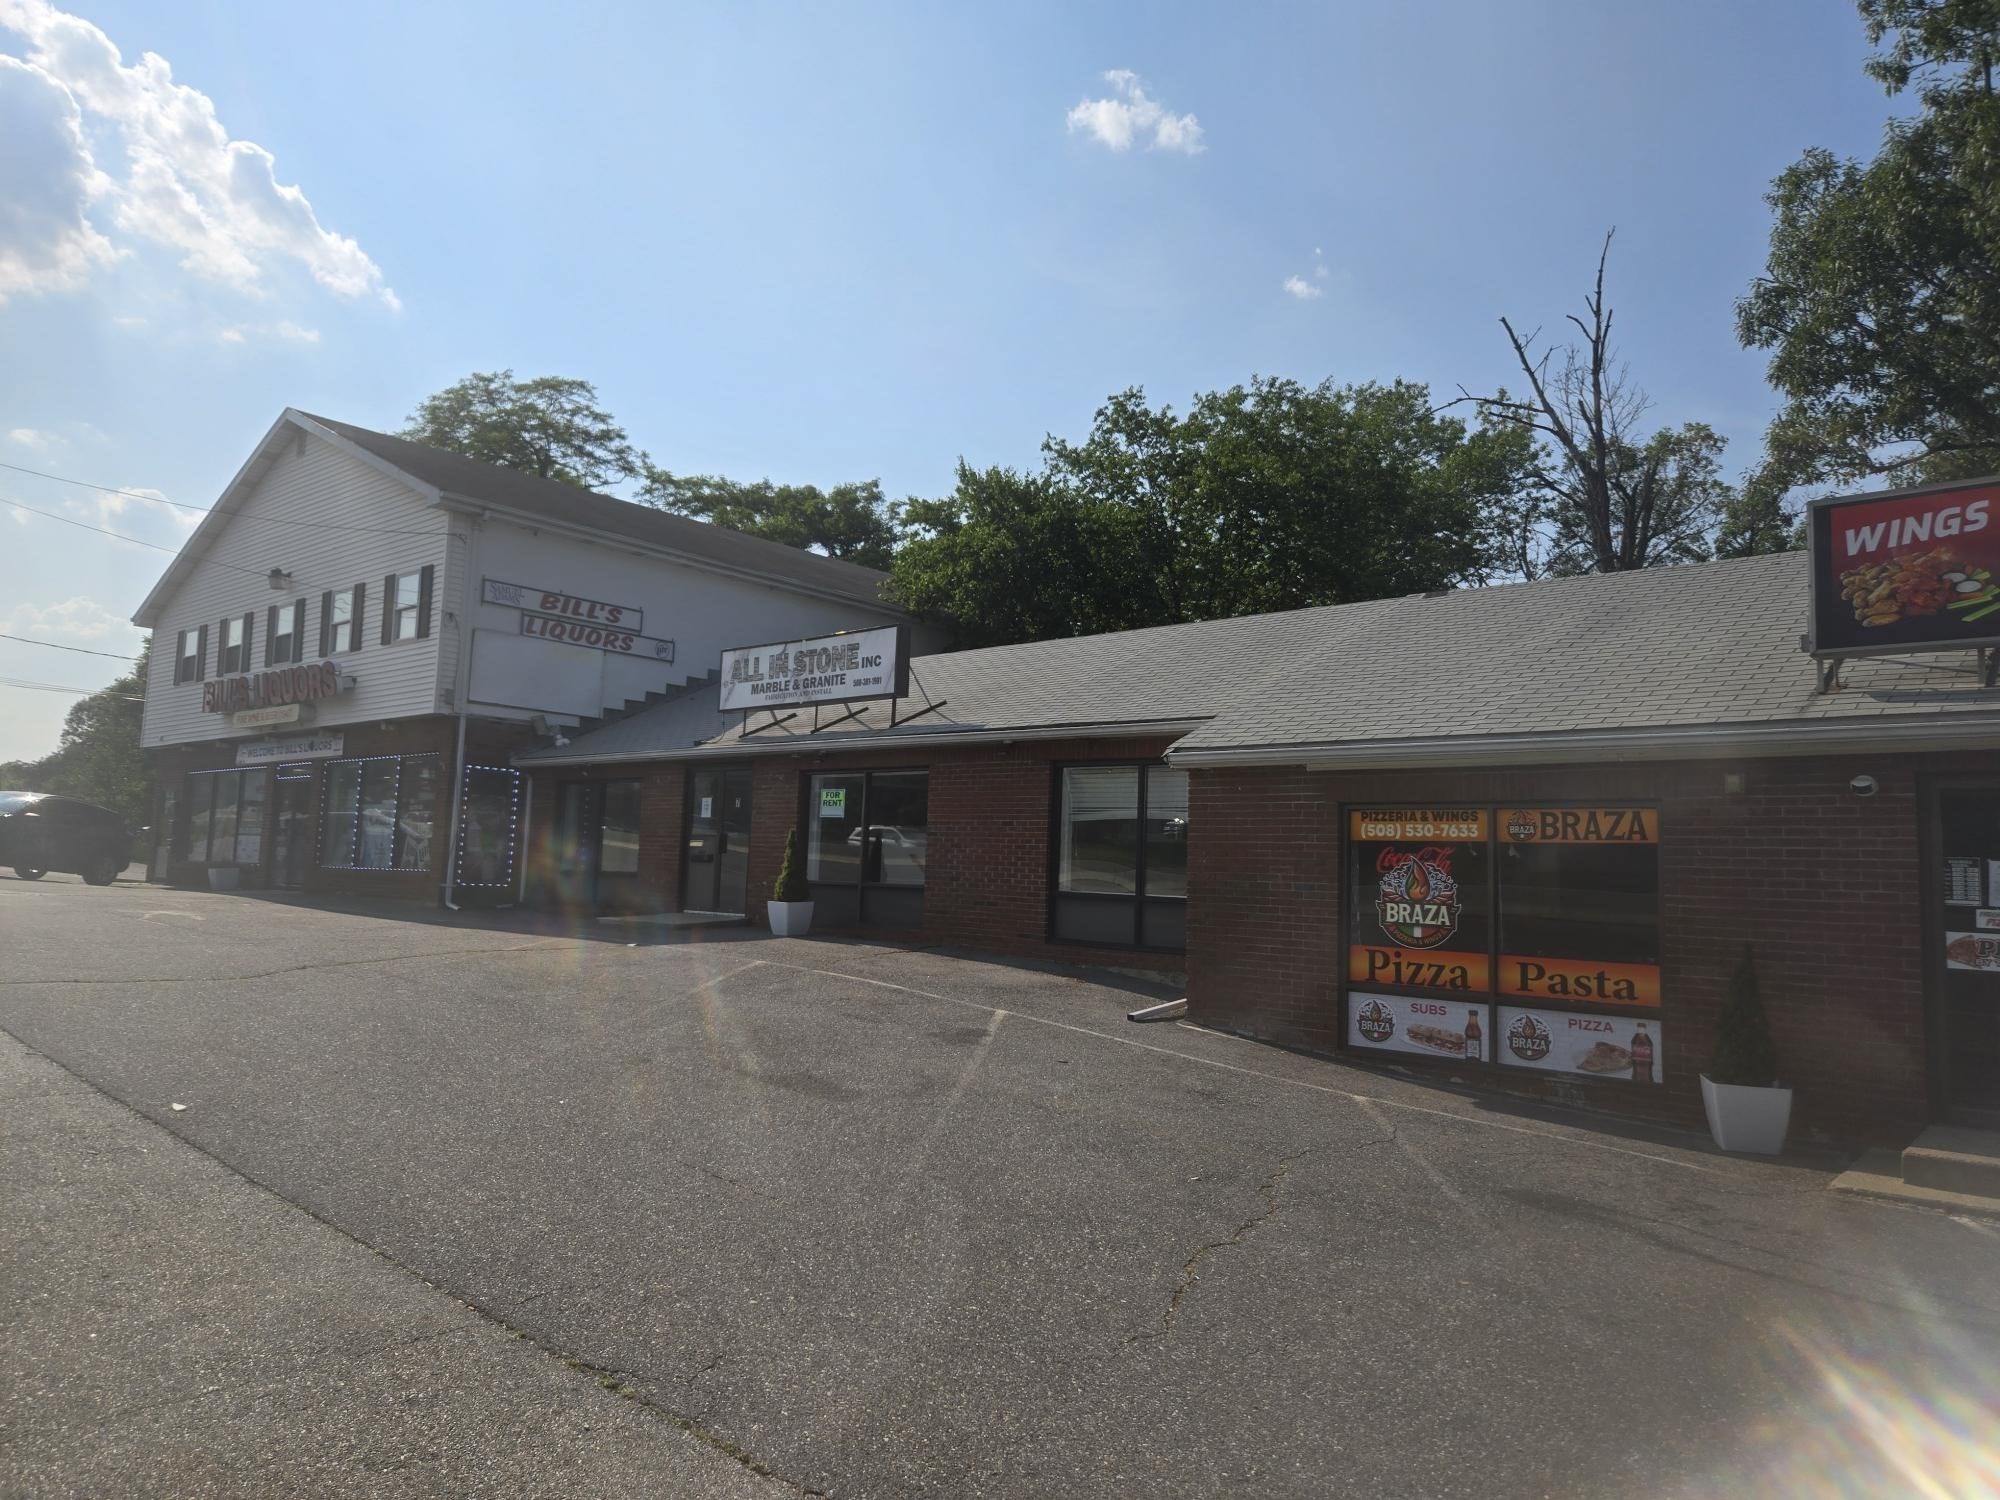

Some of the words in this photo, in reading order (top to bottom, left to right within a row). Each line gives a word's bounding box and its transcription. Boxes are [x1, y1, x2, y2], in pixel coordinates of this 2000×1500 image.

[1845, 500, 1990, 557] WINGS
[539, 592, 623, 624] BILL'S
[524, 616, 634, 652] LIQUORS
[730, 656, 764, 683] ALL
[769, 652, 789, 682] IN
[793, 642, 860, 677] STONE
[861, 655, 882, 669] INC
[202, 677, 249, 713] BILL'S
[252, 660, 337, 707] LIQUORS
[751, 678, 790, 696] MARBLE
[792, 679, 801, 691] &
[803, 673, 846, 690] GRANITE
[823, 799, 843, 807] RENT
[825, 791, 841, 799] FOR
[1361, 811, 1417, 822] PIZZERIA
[1421, 811, 1429, 822] &
[1432, 811, 1479, 822] WINGS
[1539, 810, 1649, 841] BRAZA
[1360, 823, 1401, 839] (508)
[1405, 823, 1479, 838] 530-7633
[1509, 825, 1535, 834] BRAZA
[1385, 902, 1451, 926] BRAZA
[1364, 949, 1472, 990] Pizza
[1516, 961, 1639, 1000] Pasta
[1410, 1002, 1447, 1016] SUBS
[1361, 1020, 1391, 1033] BRAZA
[1567, 1018, 1614, 1033] PIZZA
[1512, 1037, 1547, 1050] BRAZA
